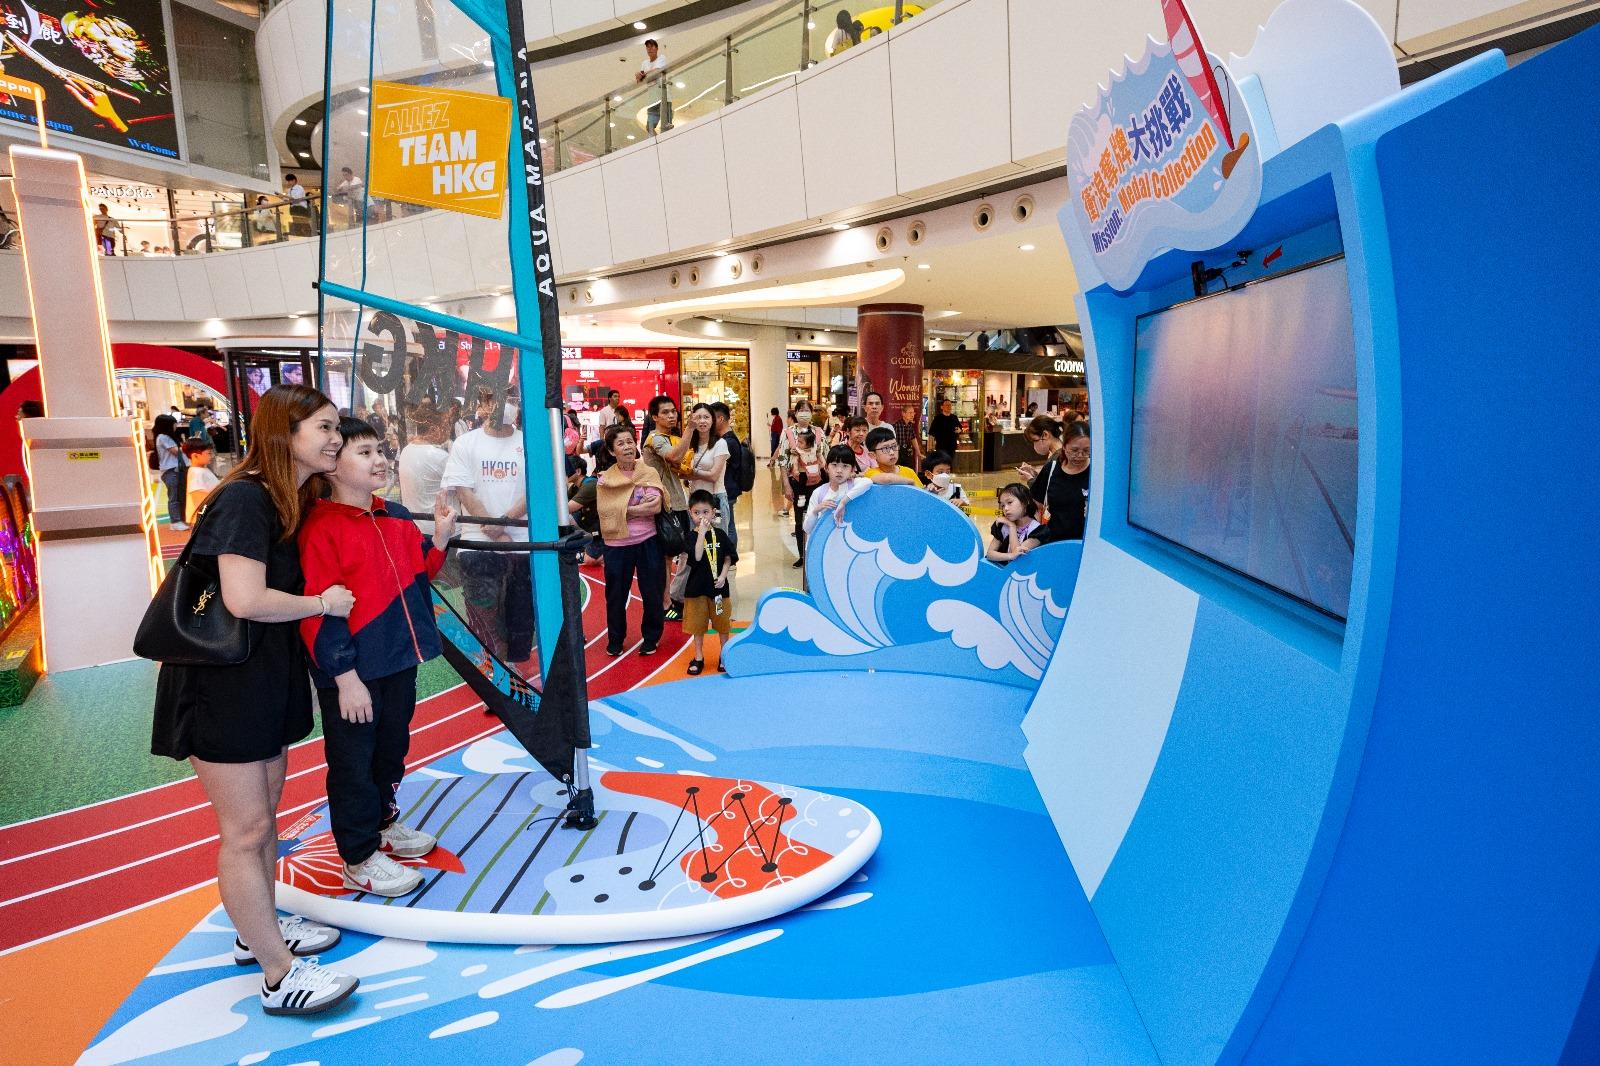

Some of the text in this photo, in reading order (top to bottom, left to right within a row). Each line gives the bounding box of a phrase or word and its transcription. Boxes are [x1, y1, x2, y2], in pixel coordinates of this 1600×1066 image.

[382, 101, 450, 138] ALLEZ
[128, 137, 178, 157] Welcome
[399, 129, 477, 166] TEAM
[90, 186, 154, 198] PANDORA
[432, 160, 497, 195] HKG
[1091, 123, 1217, 253] Mission: Medal Collection
[530, 203, 554, 298] AQUA
[889, 374, 921, 394] Wonder
[892, 391, 920, 401] Awaits
